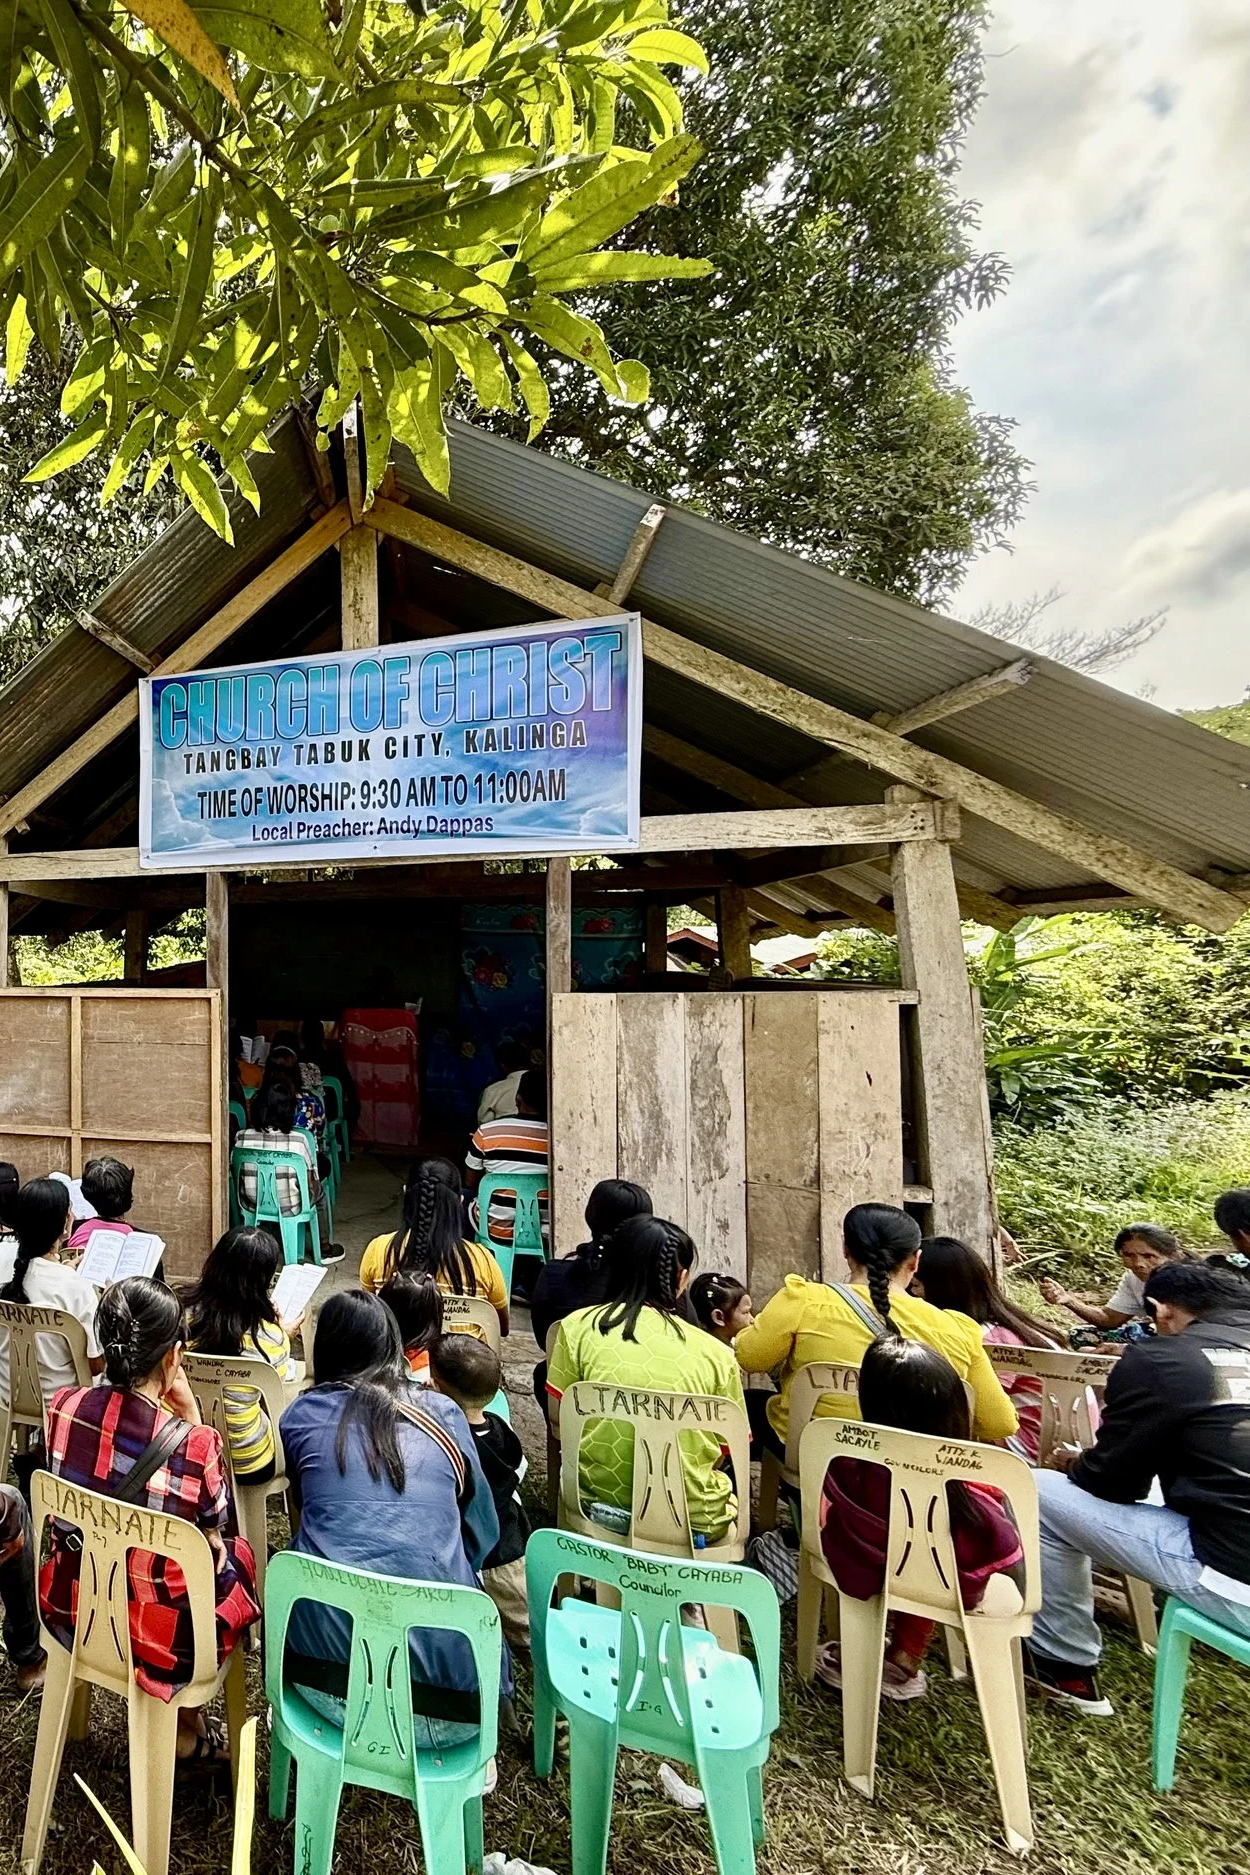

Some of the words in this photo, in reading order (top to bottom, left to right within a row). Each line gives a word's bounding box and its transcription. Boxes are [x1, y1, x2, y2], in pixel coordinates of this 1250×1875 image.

[160, 664, 340, 750] CHURCH
[350, 656, 411, 733] OF
[419, 631, 622, 727] CHRIST
[183, 746, 281, 774] TANGBAY
[294, 739, 371, 765] TABUK
[384, 732, 451, 759] CITY,
[464, 720, 587, 754] KALINGA
[197, 789, 237, 820] TIME
[240, 787, 264, 817] OF
[267, 780, 356, 816] WORSHIP:
[360, 778, 401, 810] 9:30
[405, 775, 436, 807] AM
[441, 773, 469, 806] TO
[473, 768, 567, 805] 11:00AM
[252, 821, 293, 841] Local
[296, 818, 374, 839] Preacher:
[376, 815, 423, 838] Andy
[426, 815, 494, 838] Dappas
[572, 1385, 728, 1422] L.TARNATE
[835, 1432, 881, 1451] SACAYLE
[842, 1424, 878, 1440] AMBOT
[935, 1453, 984, 1471] WANDAG
[556, 1536, 614, 1564] CASTOR
[677, 1566, 743, 1584] CAYABA
[619, 1574, 682, 1598] Councilor
